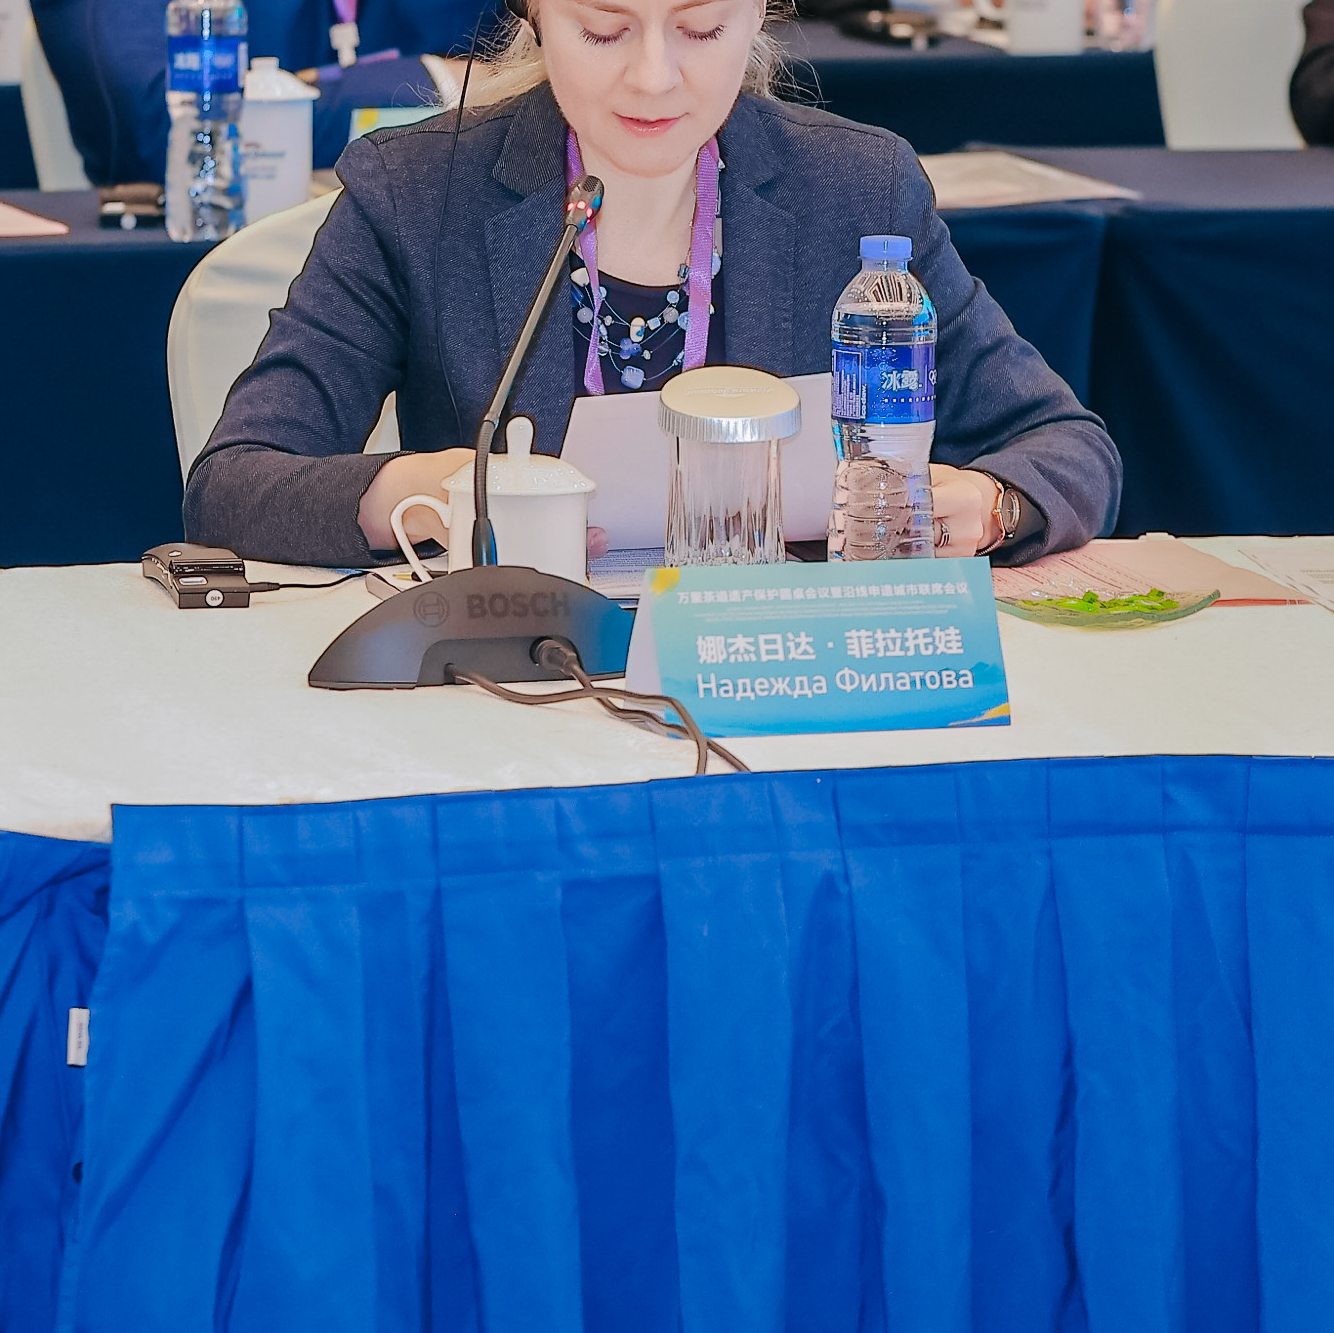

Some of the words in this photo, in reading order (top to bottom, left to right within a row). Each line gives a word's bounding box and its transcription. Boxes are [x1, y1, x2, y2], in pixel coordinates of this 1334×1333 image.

[466, 592, 566, 618] BOSCH
[697, 672, 827, 701] Надежда
[835, 666, 973, 695] Филатова
